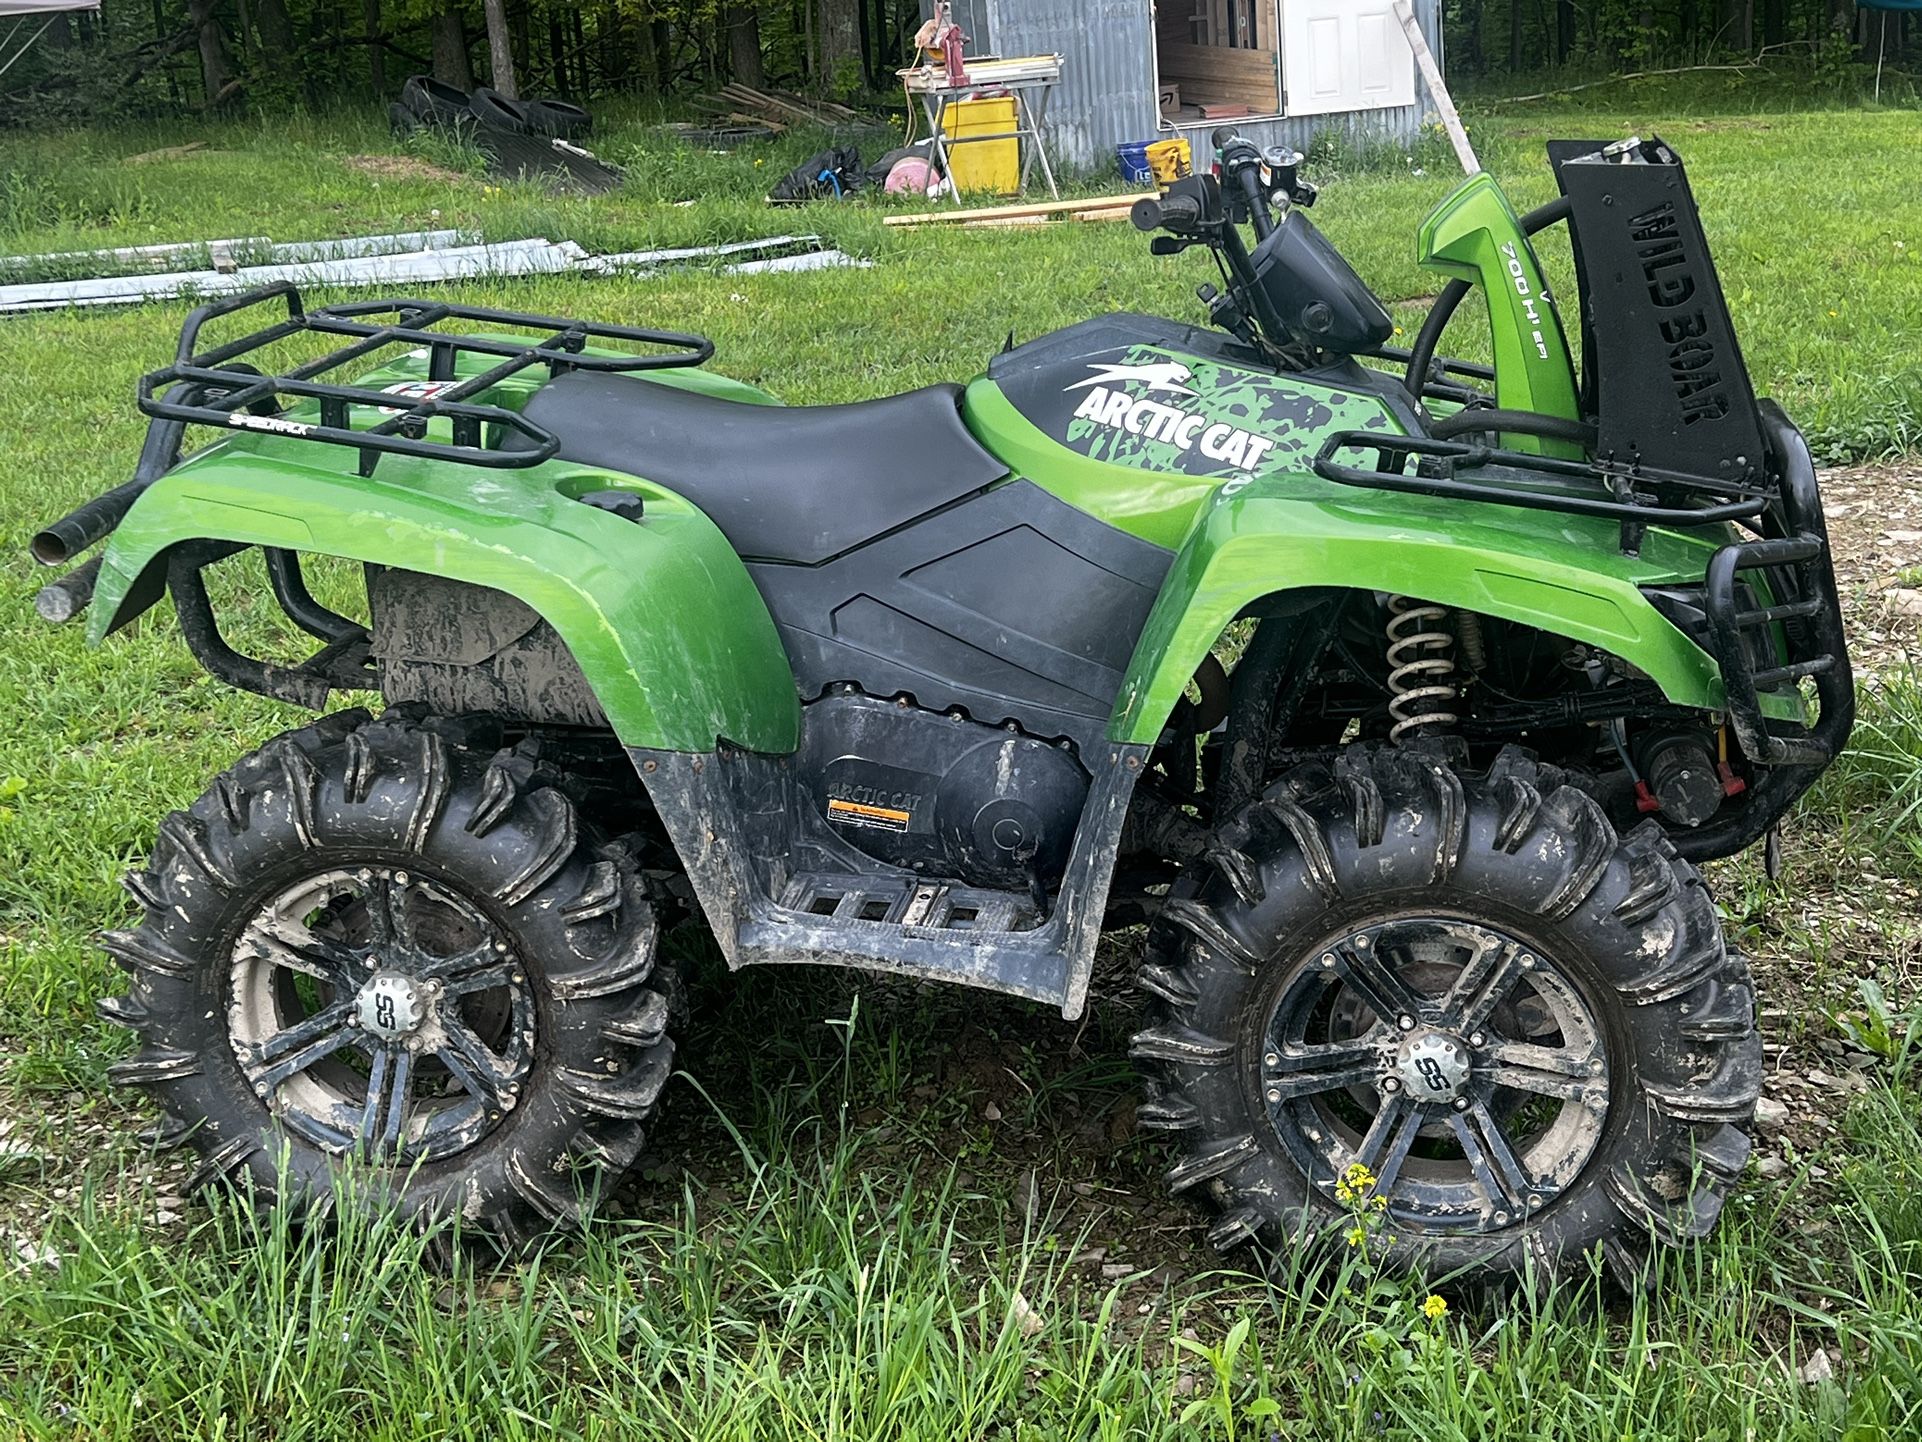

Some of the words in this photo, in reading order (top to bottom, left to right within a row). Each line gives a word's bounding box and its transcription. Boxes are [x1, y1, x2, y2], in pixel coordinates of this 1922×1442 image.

[1501, 240, 1530, 295] 700
[1627, 201, 1696, 309] WILD
[1658, 309, 1730, 427] BOAR
[1073, 386, 1207, 450] ARCTIC
[1200, 423, 1274, 471] CAT
[826, 782, 887, 806] ARCTIC
[890, 792, 922, 811] CAT
